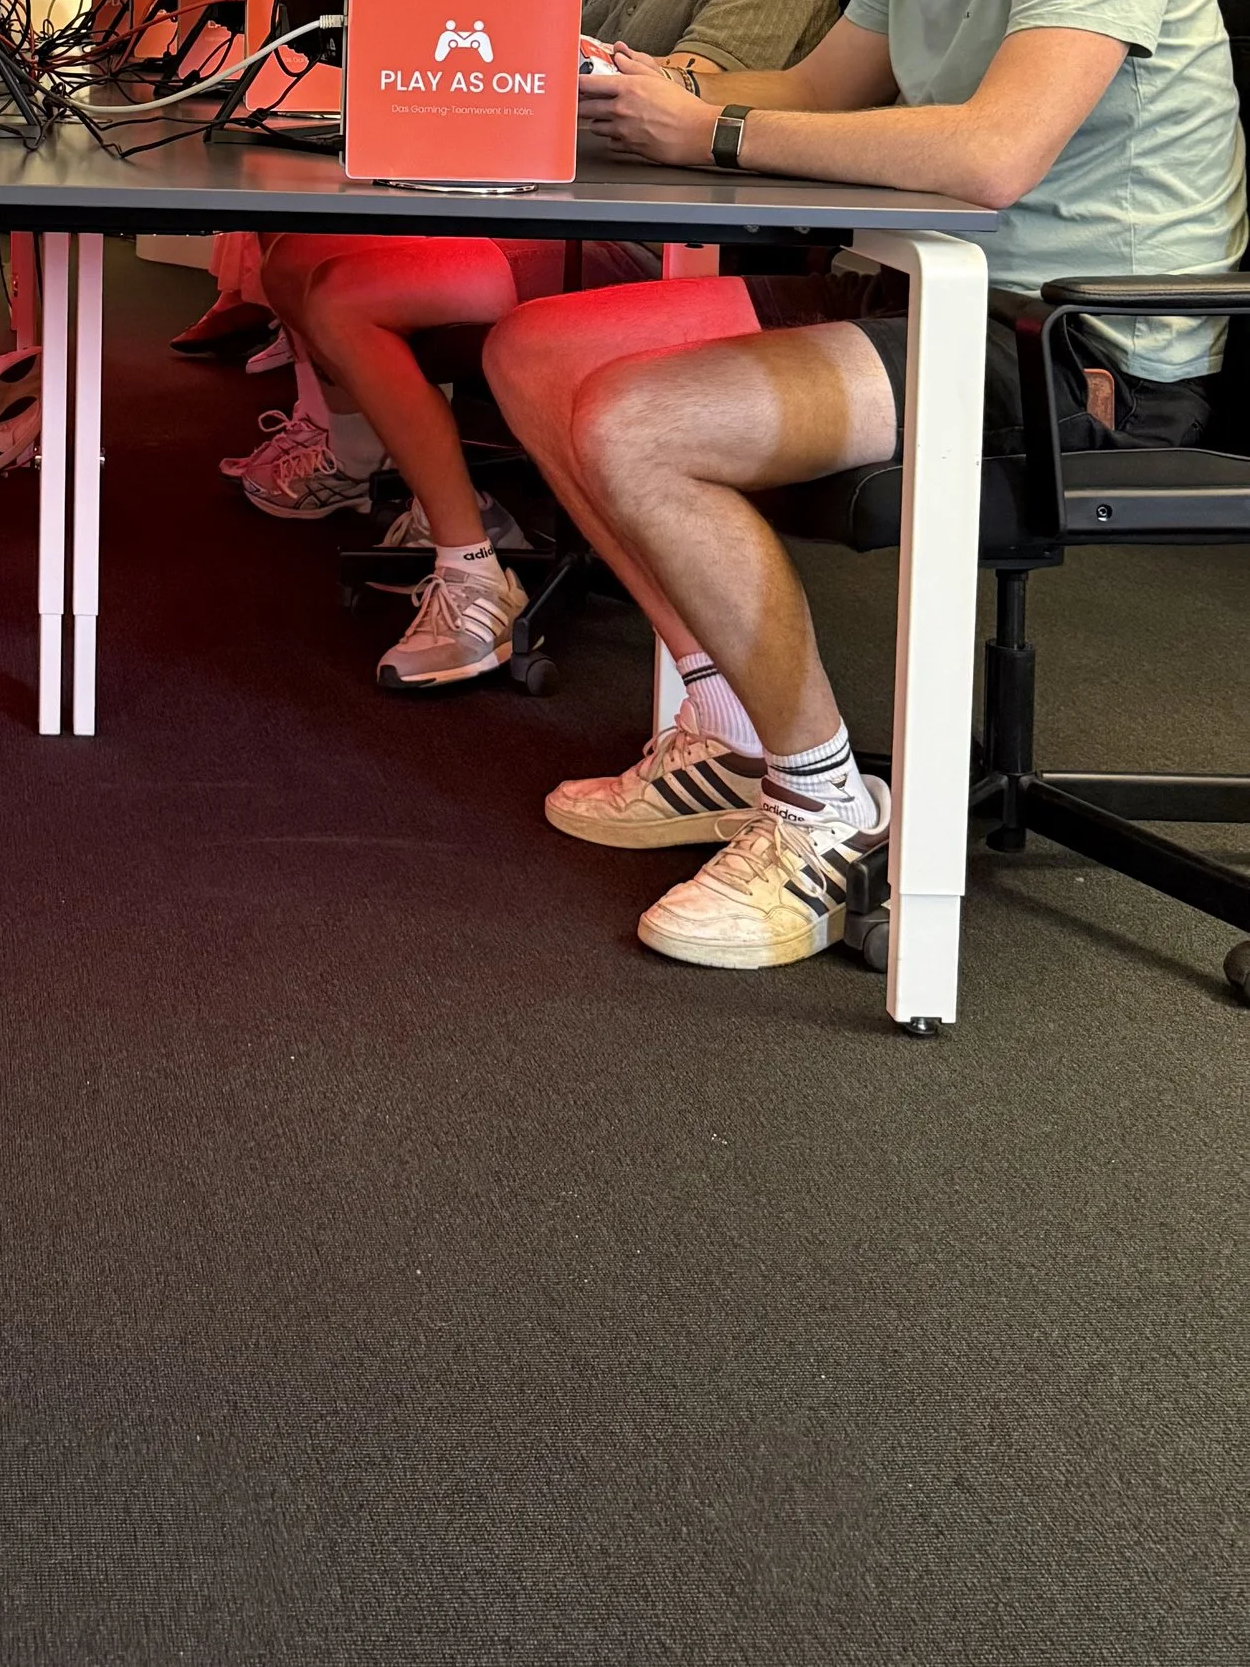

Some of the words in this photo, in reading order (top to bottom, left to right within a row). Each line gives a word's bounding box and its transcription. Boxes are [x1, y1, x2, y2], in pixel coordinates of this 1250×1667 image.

[380, 70, 443, 92] PLAY
[450, 71, 484, 93] AS
[492, 72, 546, 94] ONE
[391, 104, 409, 113] Das
[503, 107, 512, 115] in
